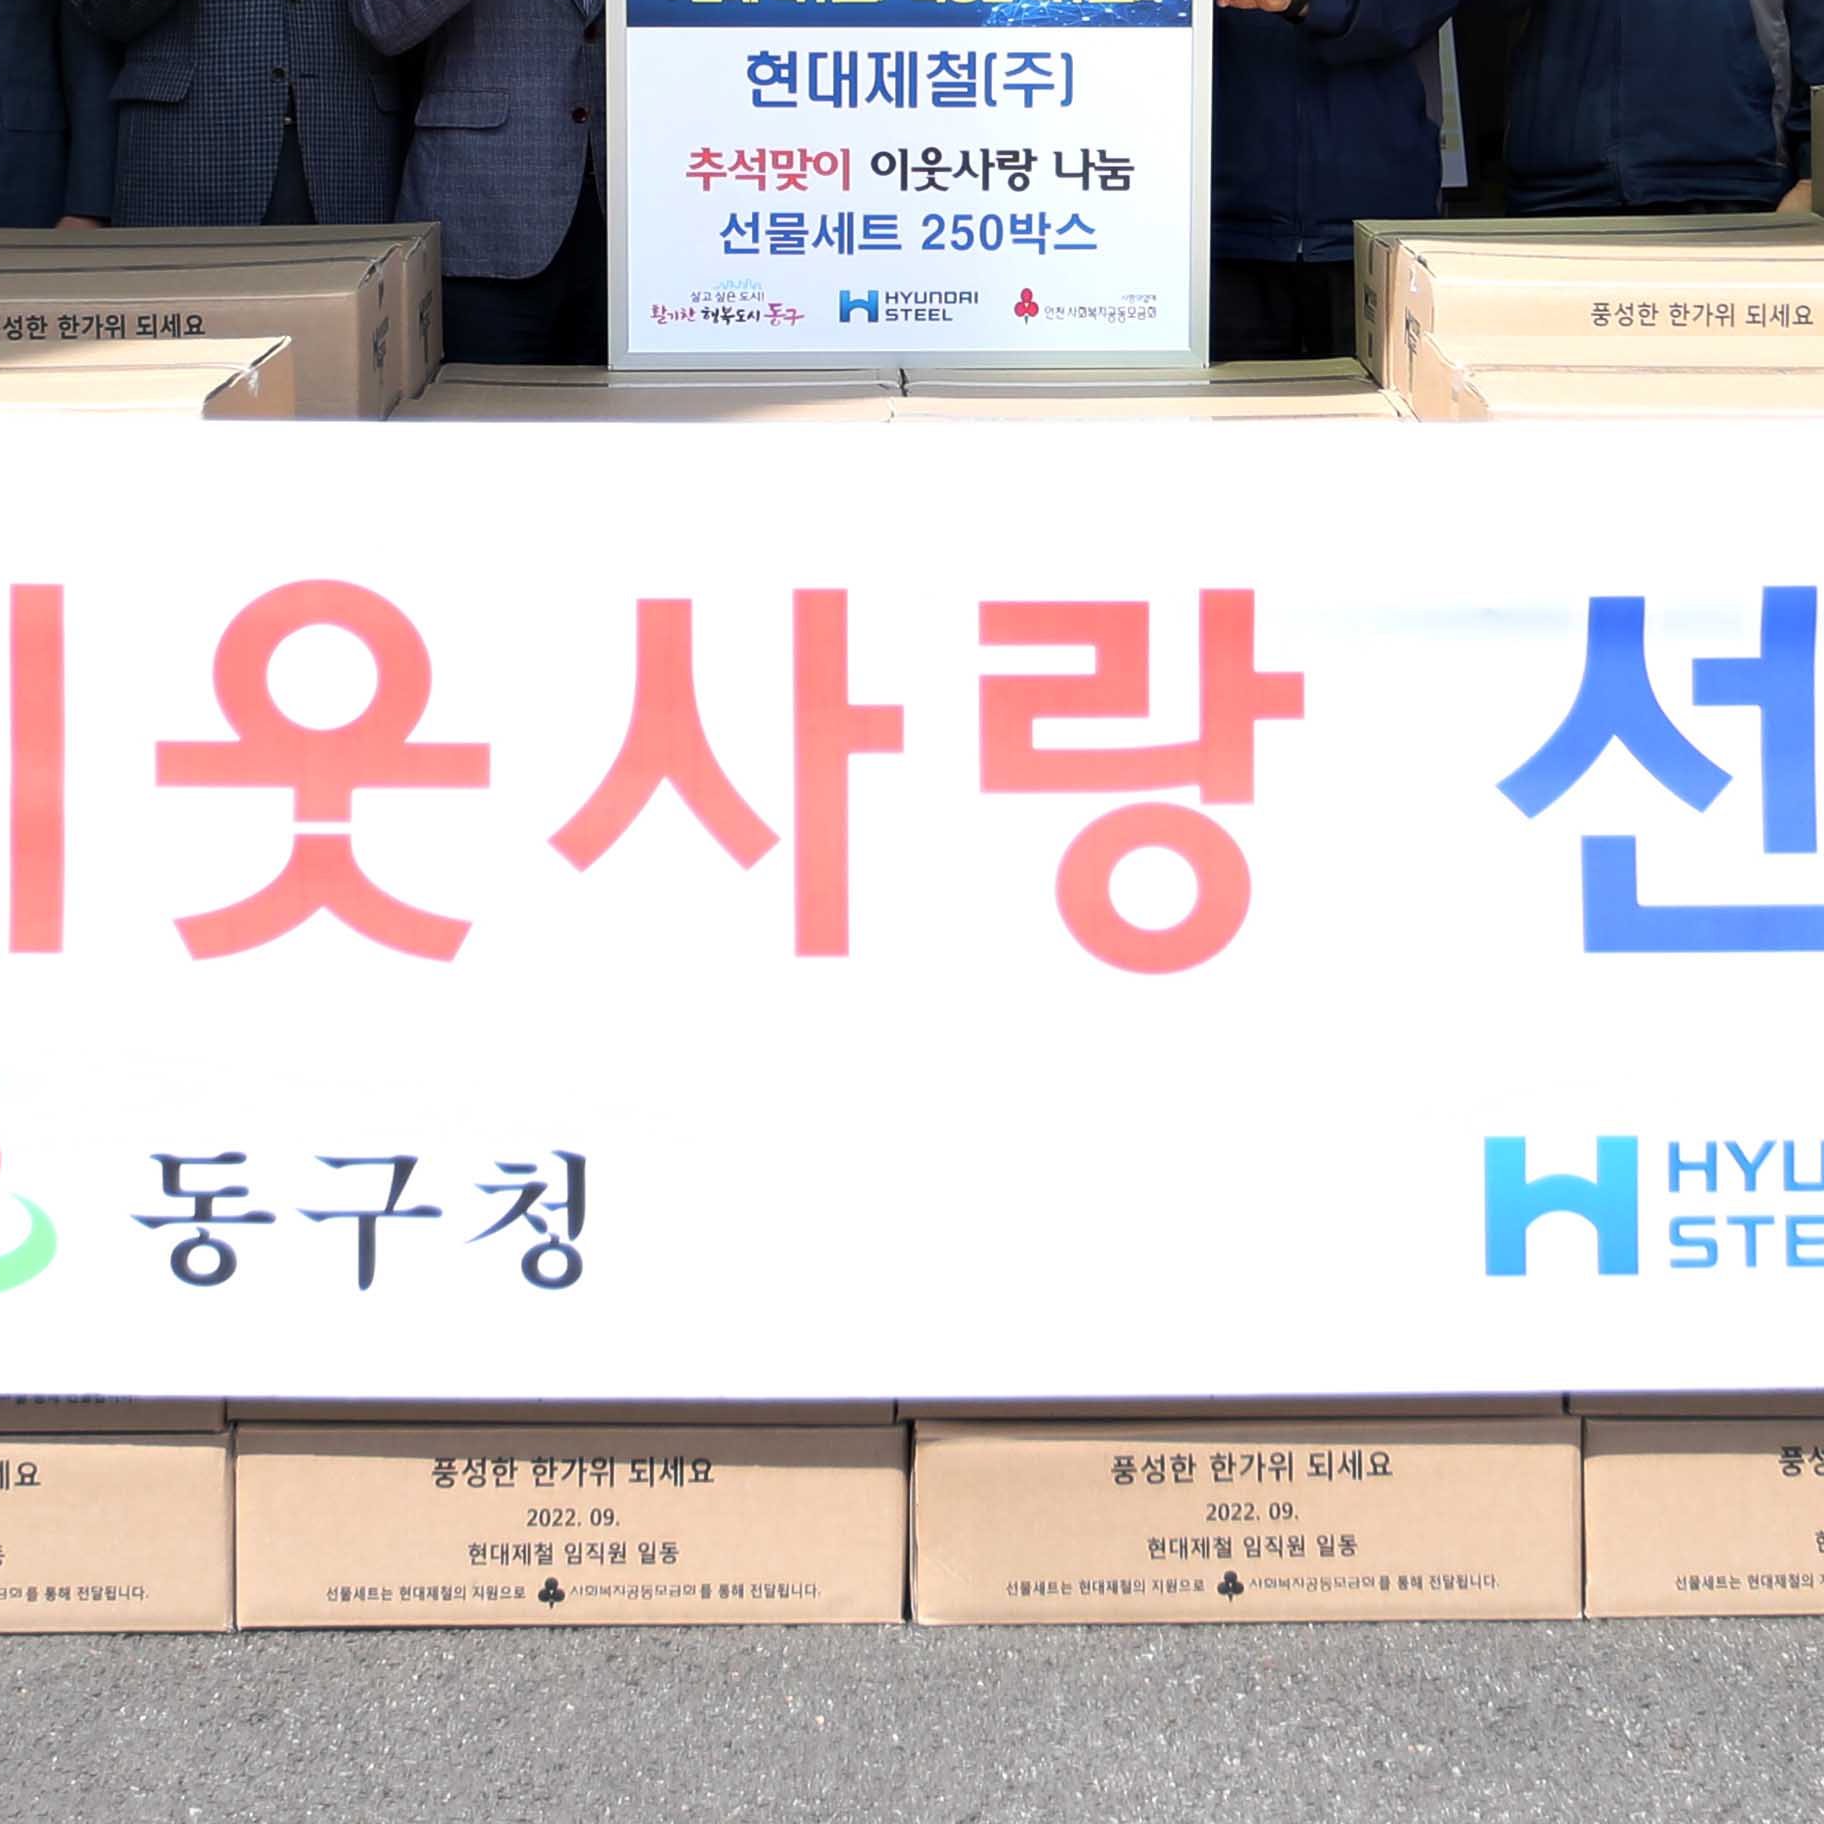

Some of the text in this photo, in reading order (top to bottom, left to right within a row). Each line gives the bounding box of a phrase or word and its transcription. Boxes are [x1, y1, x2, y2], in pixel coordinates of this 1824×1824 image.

[745, 49, 1074, 110] 현대제철(주)
[685, 148, 1136, 193] 추석맞이 이웃사랑 나눔
[718, 211, 1099, 256] 선물세트 250박스
[884, 291, 979, 305] HYUNDAI
[56, 313, 128, 342] 한가위
[135, 313, 207, 341] 되세요
[650, 302, 806, 327] 활기찬 행복도시 동구
[884, 308, 954, 322] STEEL
[1590, 302, 1815, 329] 풍성한 한가위 되세요
[129, 1148, 591, 1296] 동구청
[1110, 1449, 1393, 1486] 풍성한 한가위 되세요
[1205, 1501, 1300, 1523] 2022. 09.
[1147, 1533, 1359, 1562] 현대제철 임직원 일동
